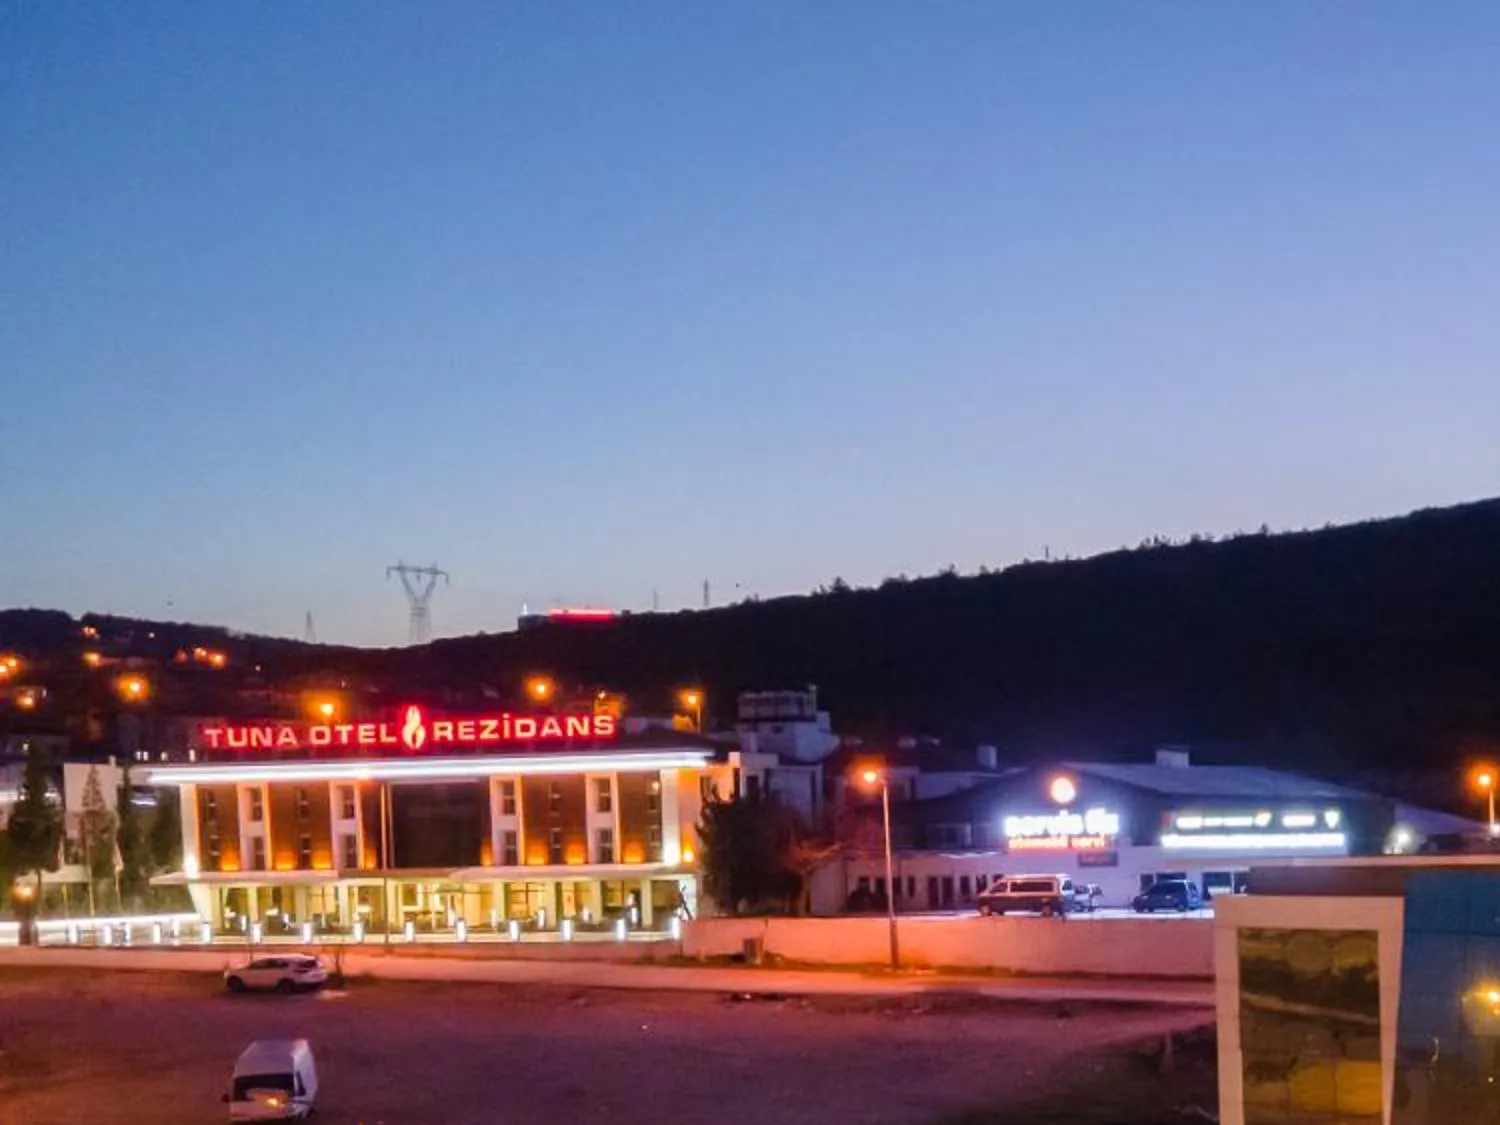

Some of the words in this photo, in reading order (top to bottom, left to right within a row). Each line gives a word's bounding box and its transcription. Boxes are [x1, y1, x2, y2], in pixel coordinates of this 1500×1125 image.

[205, 725, 299, 749] TUNA
[309, 723, 397, 746] OTEL
[433, 712, 616, 741] REZİDANS
